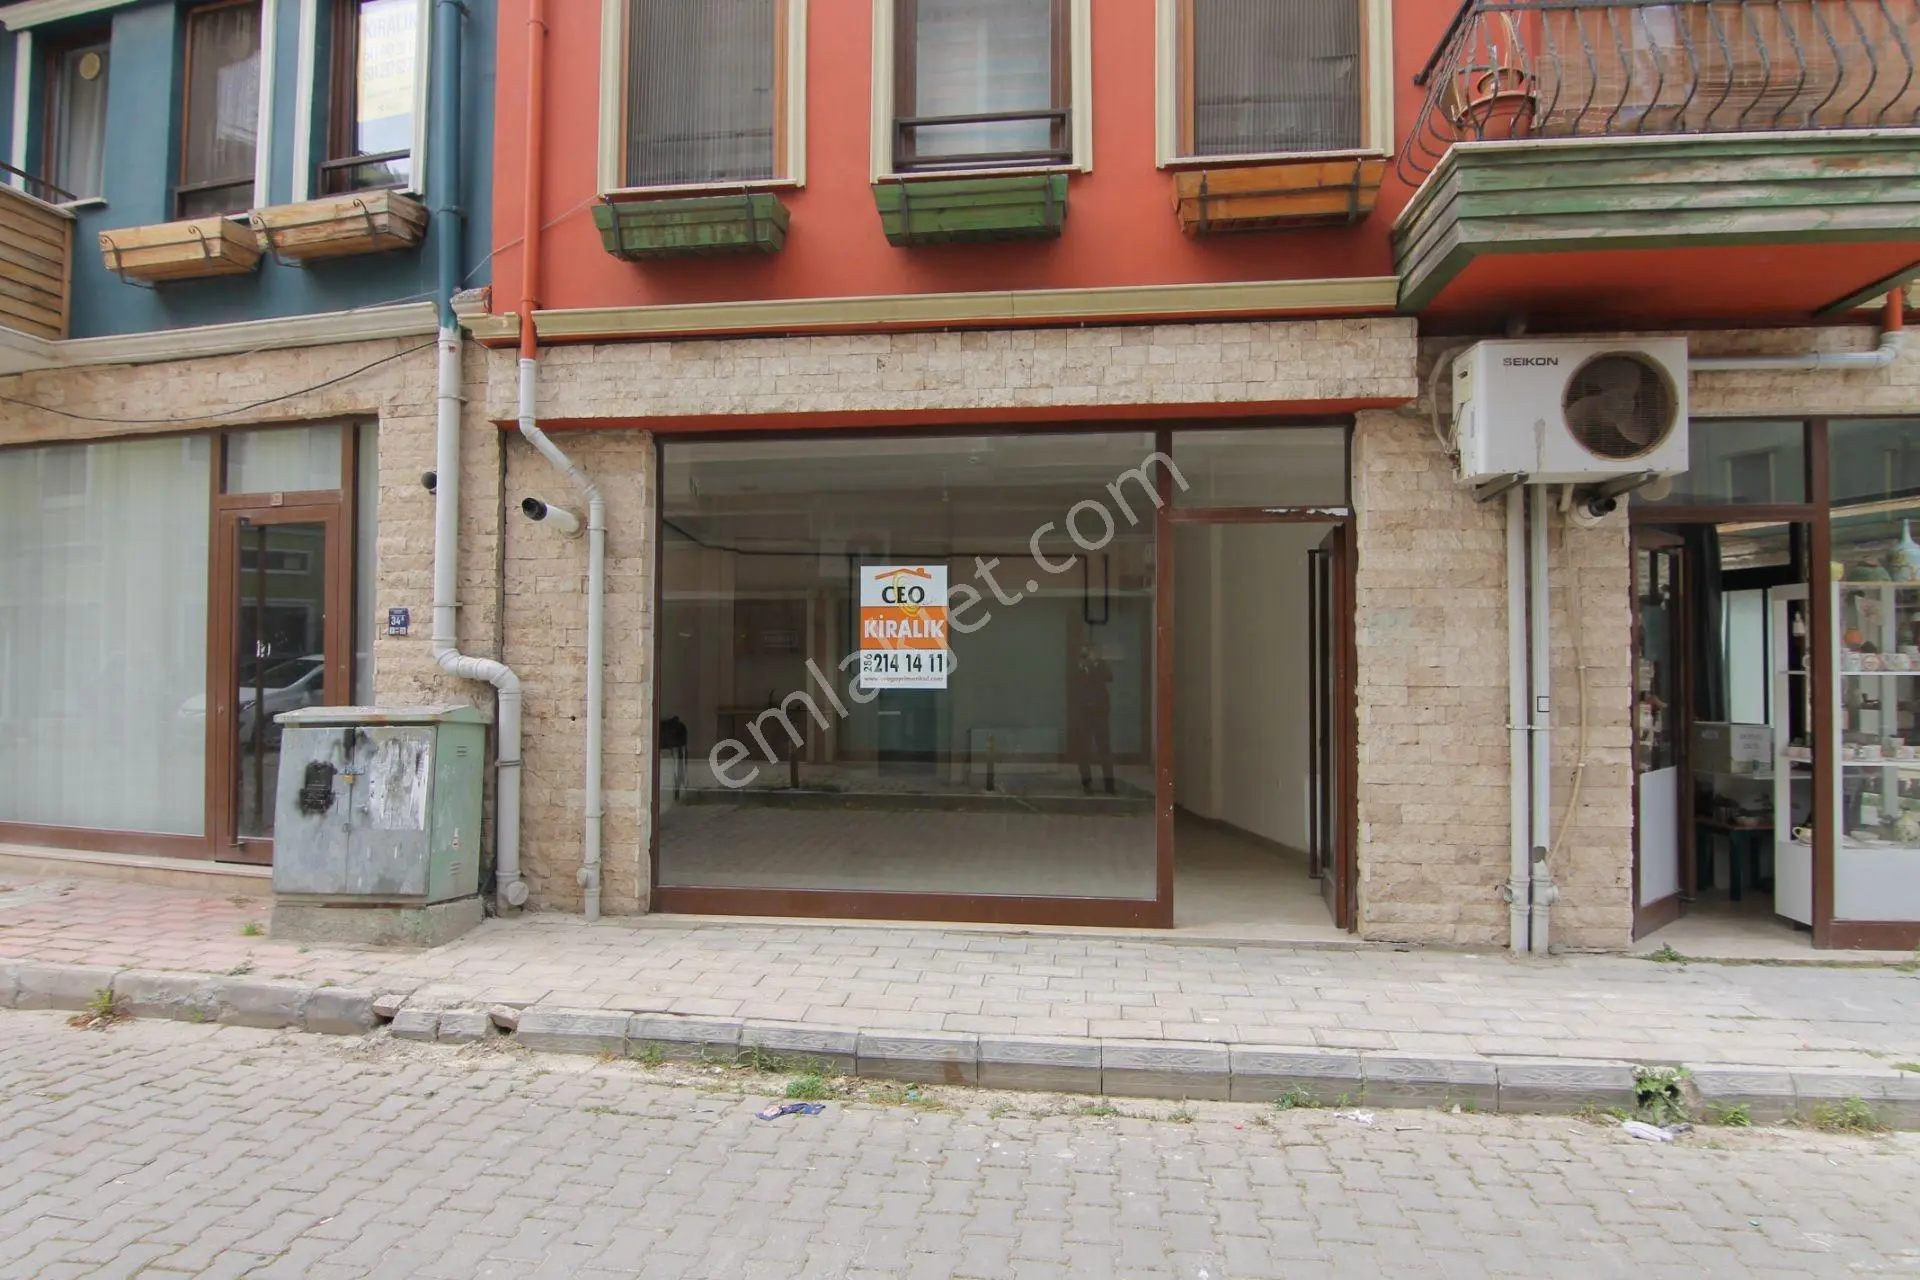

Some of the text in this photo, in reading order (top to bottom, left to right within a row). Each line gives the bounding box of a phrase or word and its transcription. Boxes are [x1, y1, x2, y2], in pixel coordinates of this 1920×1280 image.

[1503, 357, 1559, 366] SEIKON
[881, 585, 925, 604] CEO
[864, 614, 945, 639] KİRALIK
[873, 653, 900, 673] 214
[905, 653, 922, 673] 14
[928, 653, 943, 673] 11
